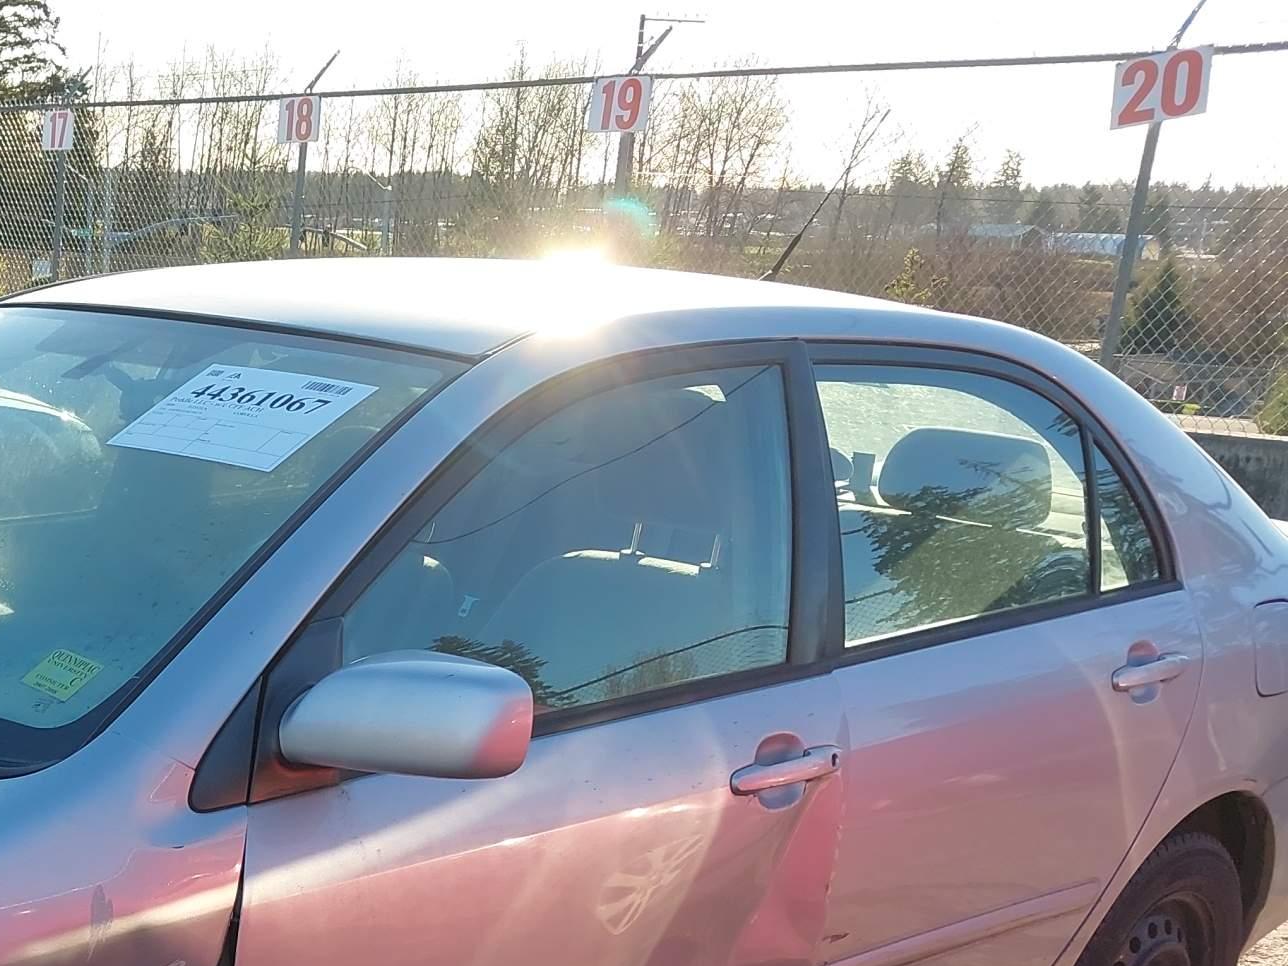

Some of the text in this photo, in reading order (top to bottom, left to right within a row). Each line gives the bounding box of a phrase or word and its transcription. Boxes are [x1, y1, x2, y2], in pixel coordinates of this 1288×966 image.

[600, 77, 643, 130] 19
[1118, 49, 1203, 126] 20
[49, 111, 69, 149] 17
[285, 97, 313, 141] 18
[191, 383, 333, 415] 44361067
[47, 658, 88, 678] UNIVERSITY
[51, 650, 101, 674] QUINNIPIAC
[69, 677, 83, 687] C
